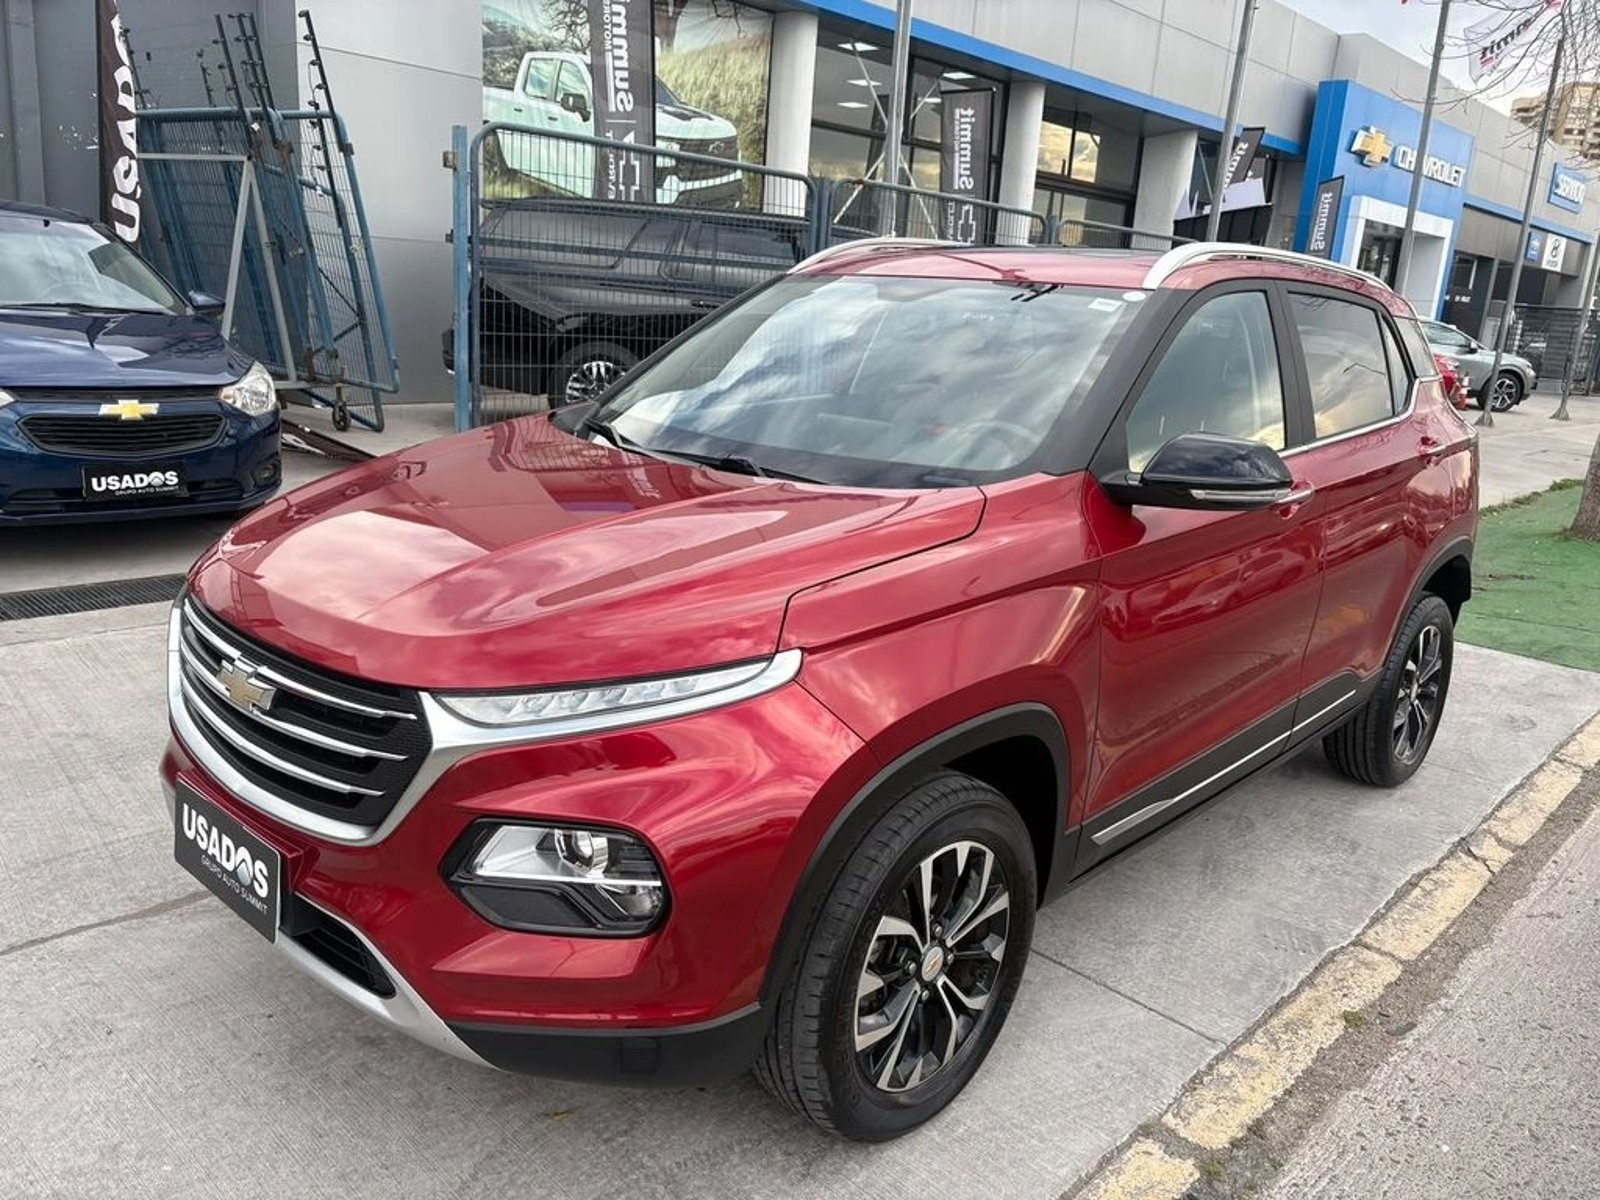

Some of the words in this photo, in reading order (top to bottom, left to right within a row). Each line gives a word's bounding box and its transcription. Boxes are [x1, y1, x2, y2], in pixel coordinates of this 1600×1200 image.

[1396, 145, 1466, 187] CHVROLET
[91, 471, 179, 492] USADOS
[183, 802, 269, 898] USADOS
[201, 855, 222, 878] GRUPO
[223, 873, 240, 894] AUTO
[241, 887, 268, 915] SUMMIT
